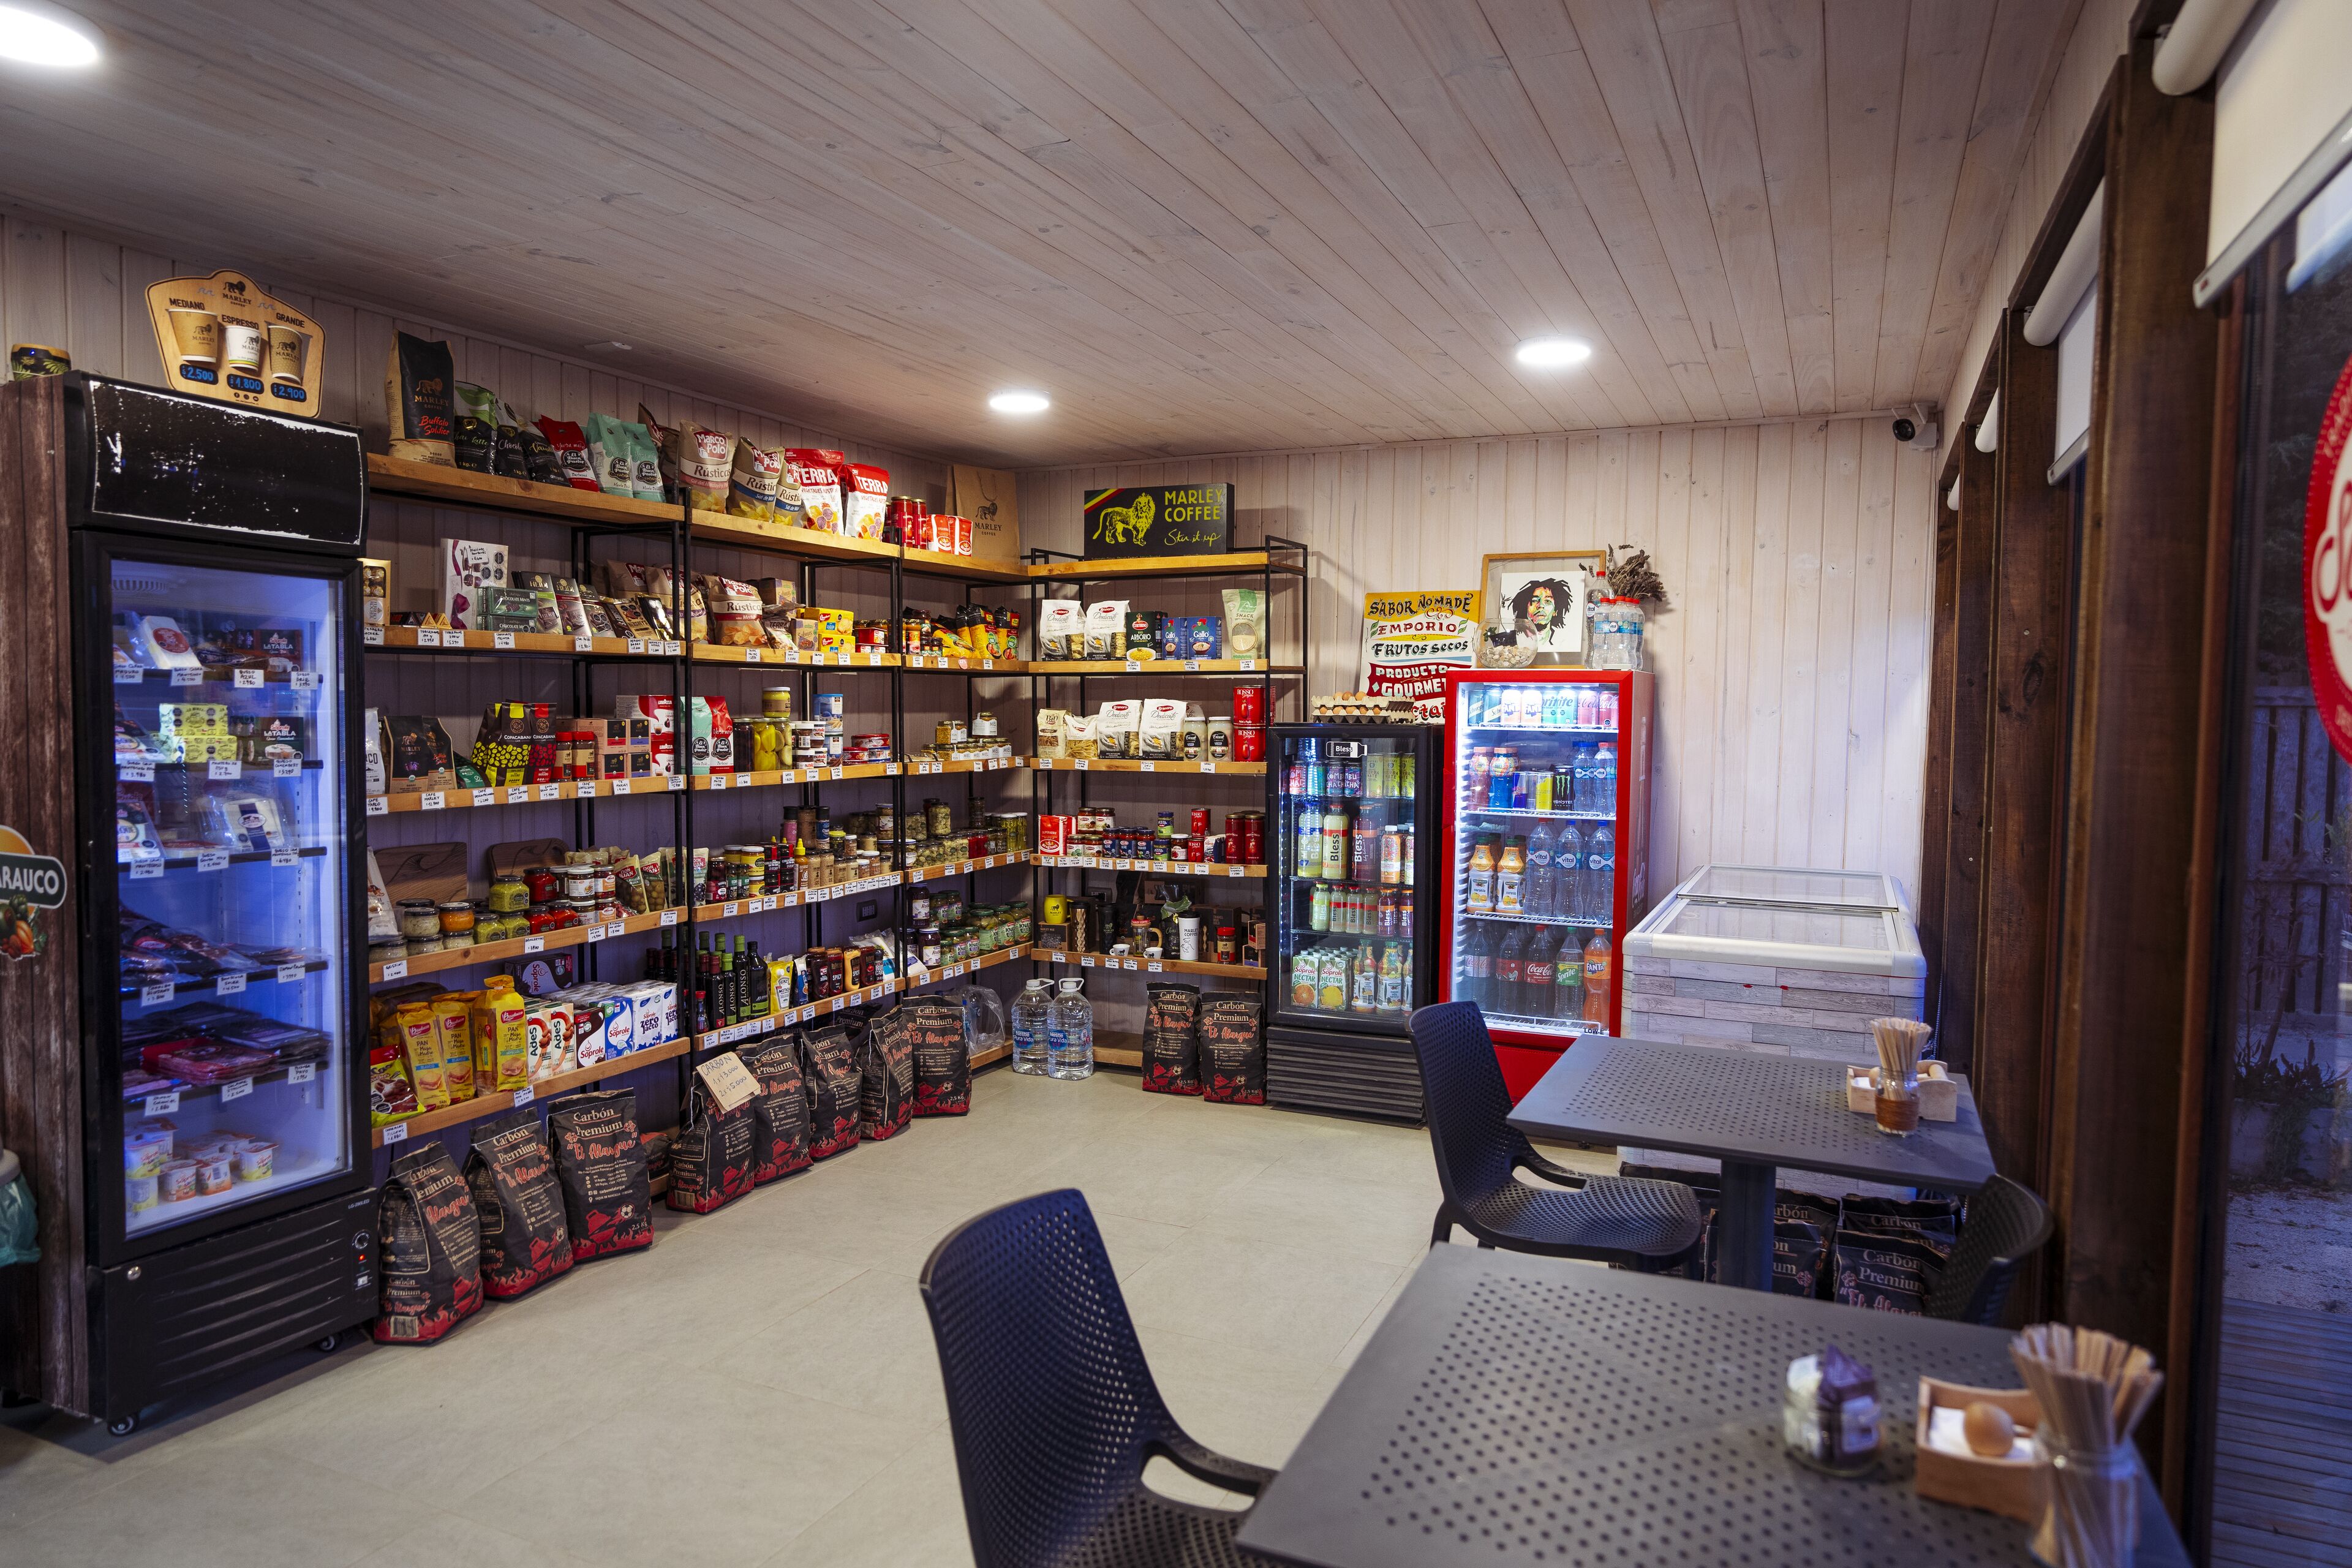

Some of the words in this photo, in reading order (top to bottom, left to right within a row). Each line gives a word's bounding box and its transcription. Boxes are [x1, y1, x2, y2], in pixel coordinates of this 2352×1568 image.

[169, 298, 205, 311] MEDIANO
[222, 293, 252, 305] MARLEY
[222, 314, 259, 330] ESPRESSO
[276, 312, 305, 328] GRANDE
[414, 394, 450, 407] MARLEY
[419, 415, 449, 427] Buffalo
[423, 425, 450, 436] Soldier
[706, 443, 726, 454] Polo
[856, 475, 888, 494] TERRA
[1164, 489, 1223, 505] MARLEY
[1164, 505, 1221, 522] COFFEE
[974, 522, 1002, 532] MARLEY
[1368, 598, 1417, 616] SABOR
[1047, 613, 1071, 624] Dedicato
[1093, 612, 1118, 621] Dedicato
[1378, 622, 1457, 635] EMPORIO
[1372, 643, 1428, 657] FRUTOS
[1376, 665, 1449, 679] PRODUCTO
[1381, 678, 1446, 697] GOURMET
[1106, 709, 1131, 719] Dedicato
[1151, 710, 1179, 720] Dedicato
[1330, 833, 1339, 861] Bless
[0, 865, 59, 895] RAUCO
[1322, 968, 1343, 976] Soprole
[1586, 962, 1605, 971] FANTA
[1294, 973, 1316, 982] NÉCTAR
[1557, 968, 1576, 982] Sprite
[740, 969, 749, 1006] ALONSO
[1160, 991, 1185, 1000] Carbón
[1158, 1002, 1186, 1011] Premium
[502, 1011, 524, 1020] Bauducco
[916, 1017, 952, 1025] Premium
[1214, 1012, 1248, 1021] Premium
[446, 1017, 466, 1027] Bauducco
[641, 1017, 659, 1028] zero
[643, 1022, 658, 1034] lacto
[409, 1024, 431, 1035] Bauducco
[609, 1027, 630, 1038] Soprole
[581, 1046, 604, 1058] Soprole
[701, 1055, 732, 1076] CARBON
[756, 1061, 793, 1075] Premium
[726, 1076, 747, 1092] $5.000
[573, 1107, 614, 1122] Carbón
[575, 1121, 624, 1137] Premium
[492, 1128, 530, 1147] Carbón
[674, 1160, 693, 1169] Carbón
[674, 1168, 696, 1177] Premium
[1863, 1250, 1921, 1268] Carbón
[387, 1287, 421, 1297] Premium
